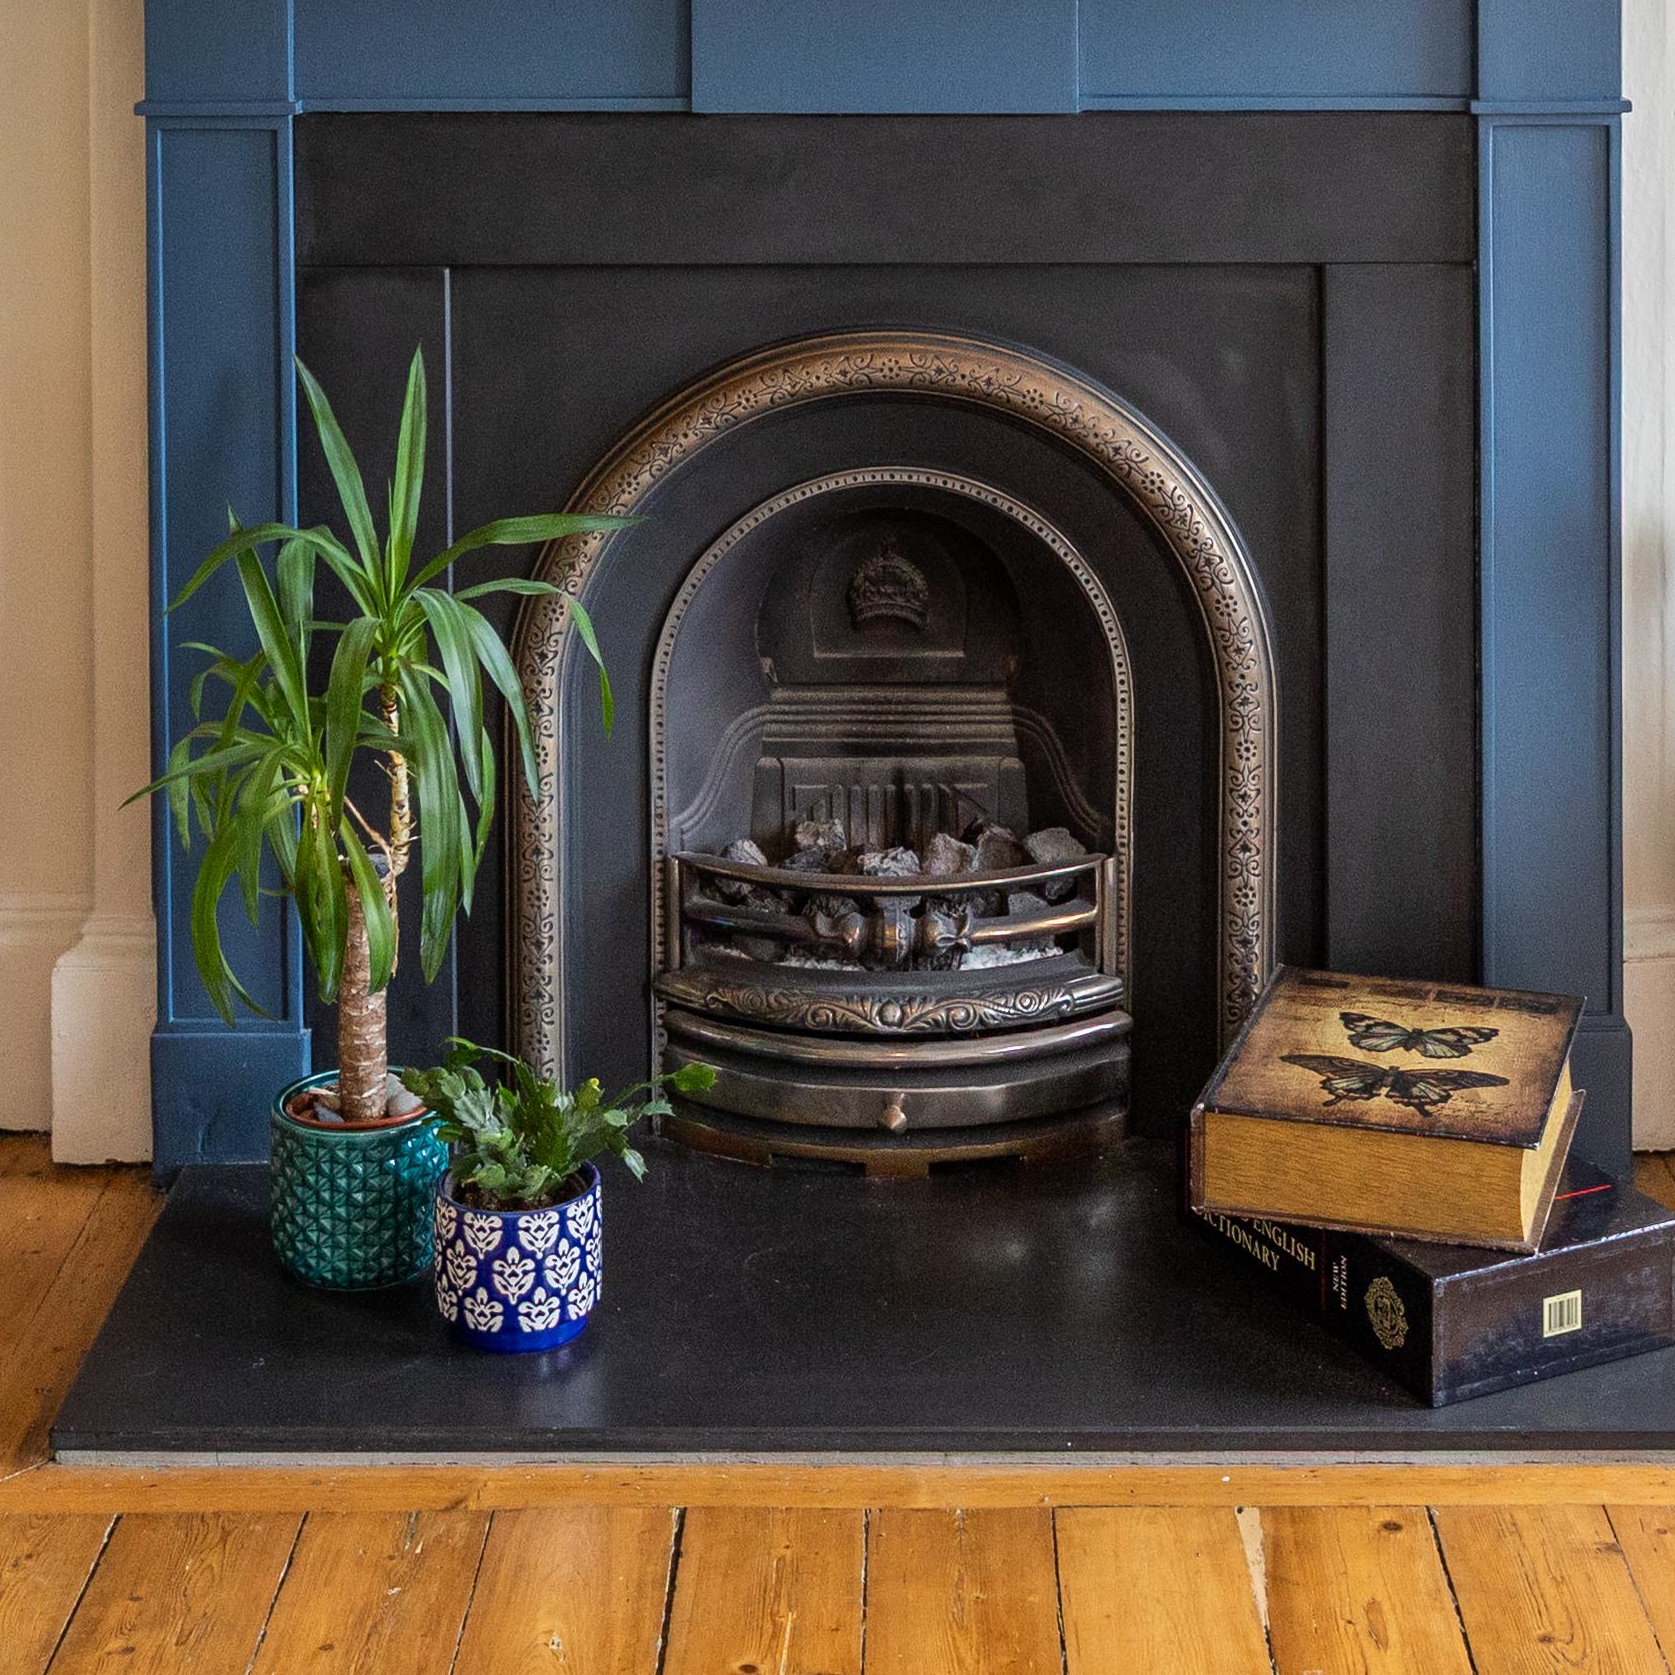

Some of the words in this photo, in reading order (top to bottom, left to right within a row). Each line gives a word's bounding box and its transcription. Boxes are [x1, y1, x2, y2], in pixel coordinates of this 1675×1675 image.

[1200, 1211, 1280, 1271] ICTIONARY
[1253, 1218, 1317, 1271] ENGLISH
[1332, 1261, 1340, 1292] NEW
[1340, 1255, 1349, 1310] EDITION
